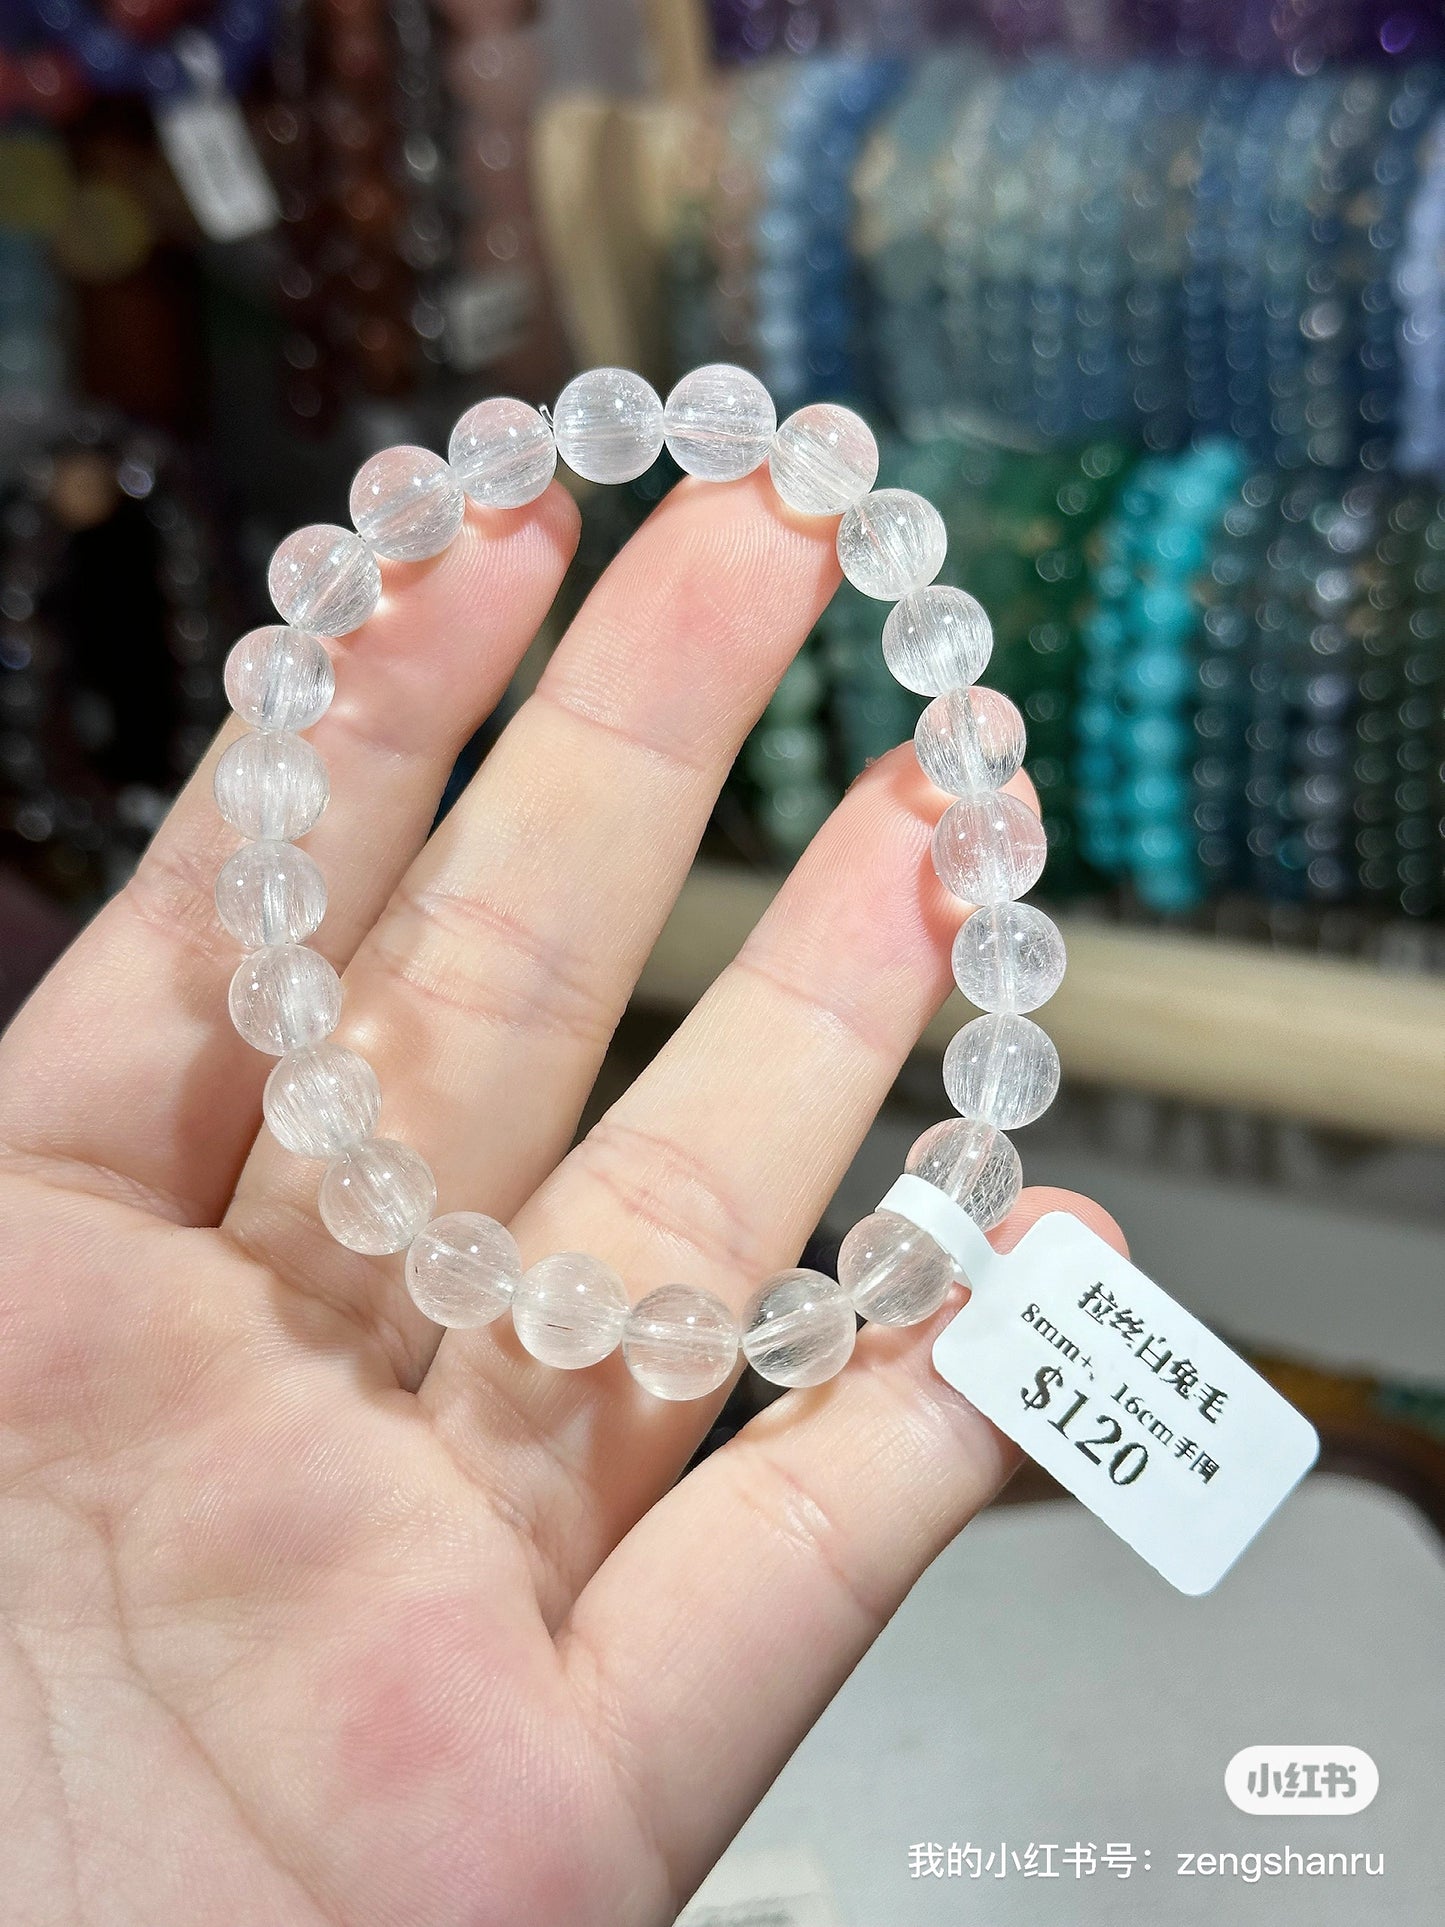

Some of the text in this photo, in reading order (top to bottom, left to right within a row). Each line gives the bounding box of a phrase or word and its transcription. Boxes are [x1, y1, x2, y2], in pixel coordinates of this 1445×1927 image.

[1077, 1280, 1229, 1425] 拉丝白兔毛
[1020, 1365, 1149, 1487] $120
